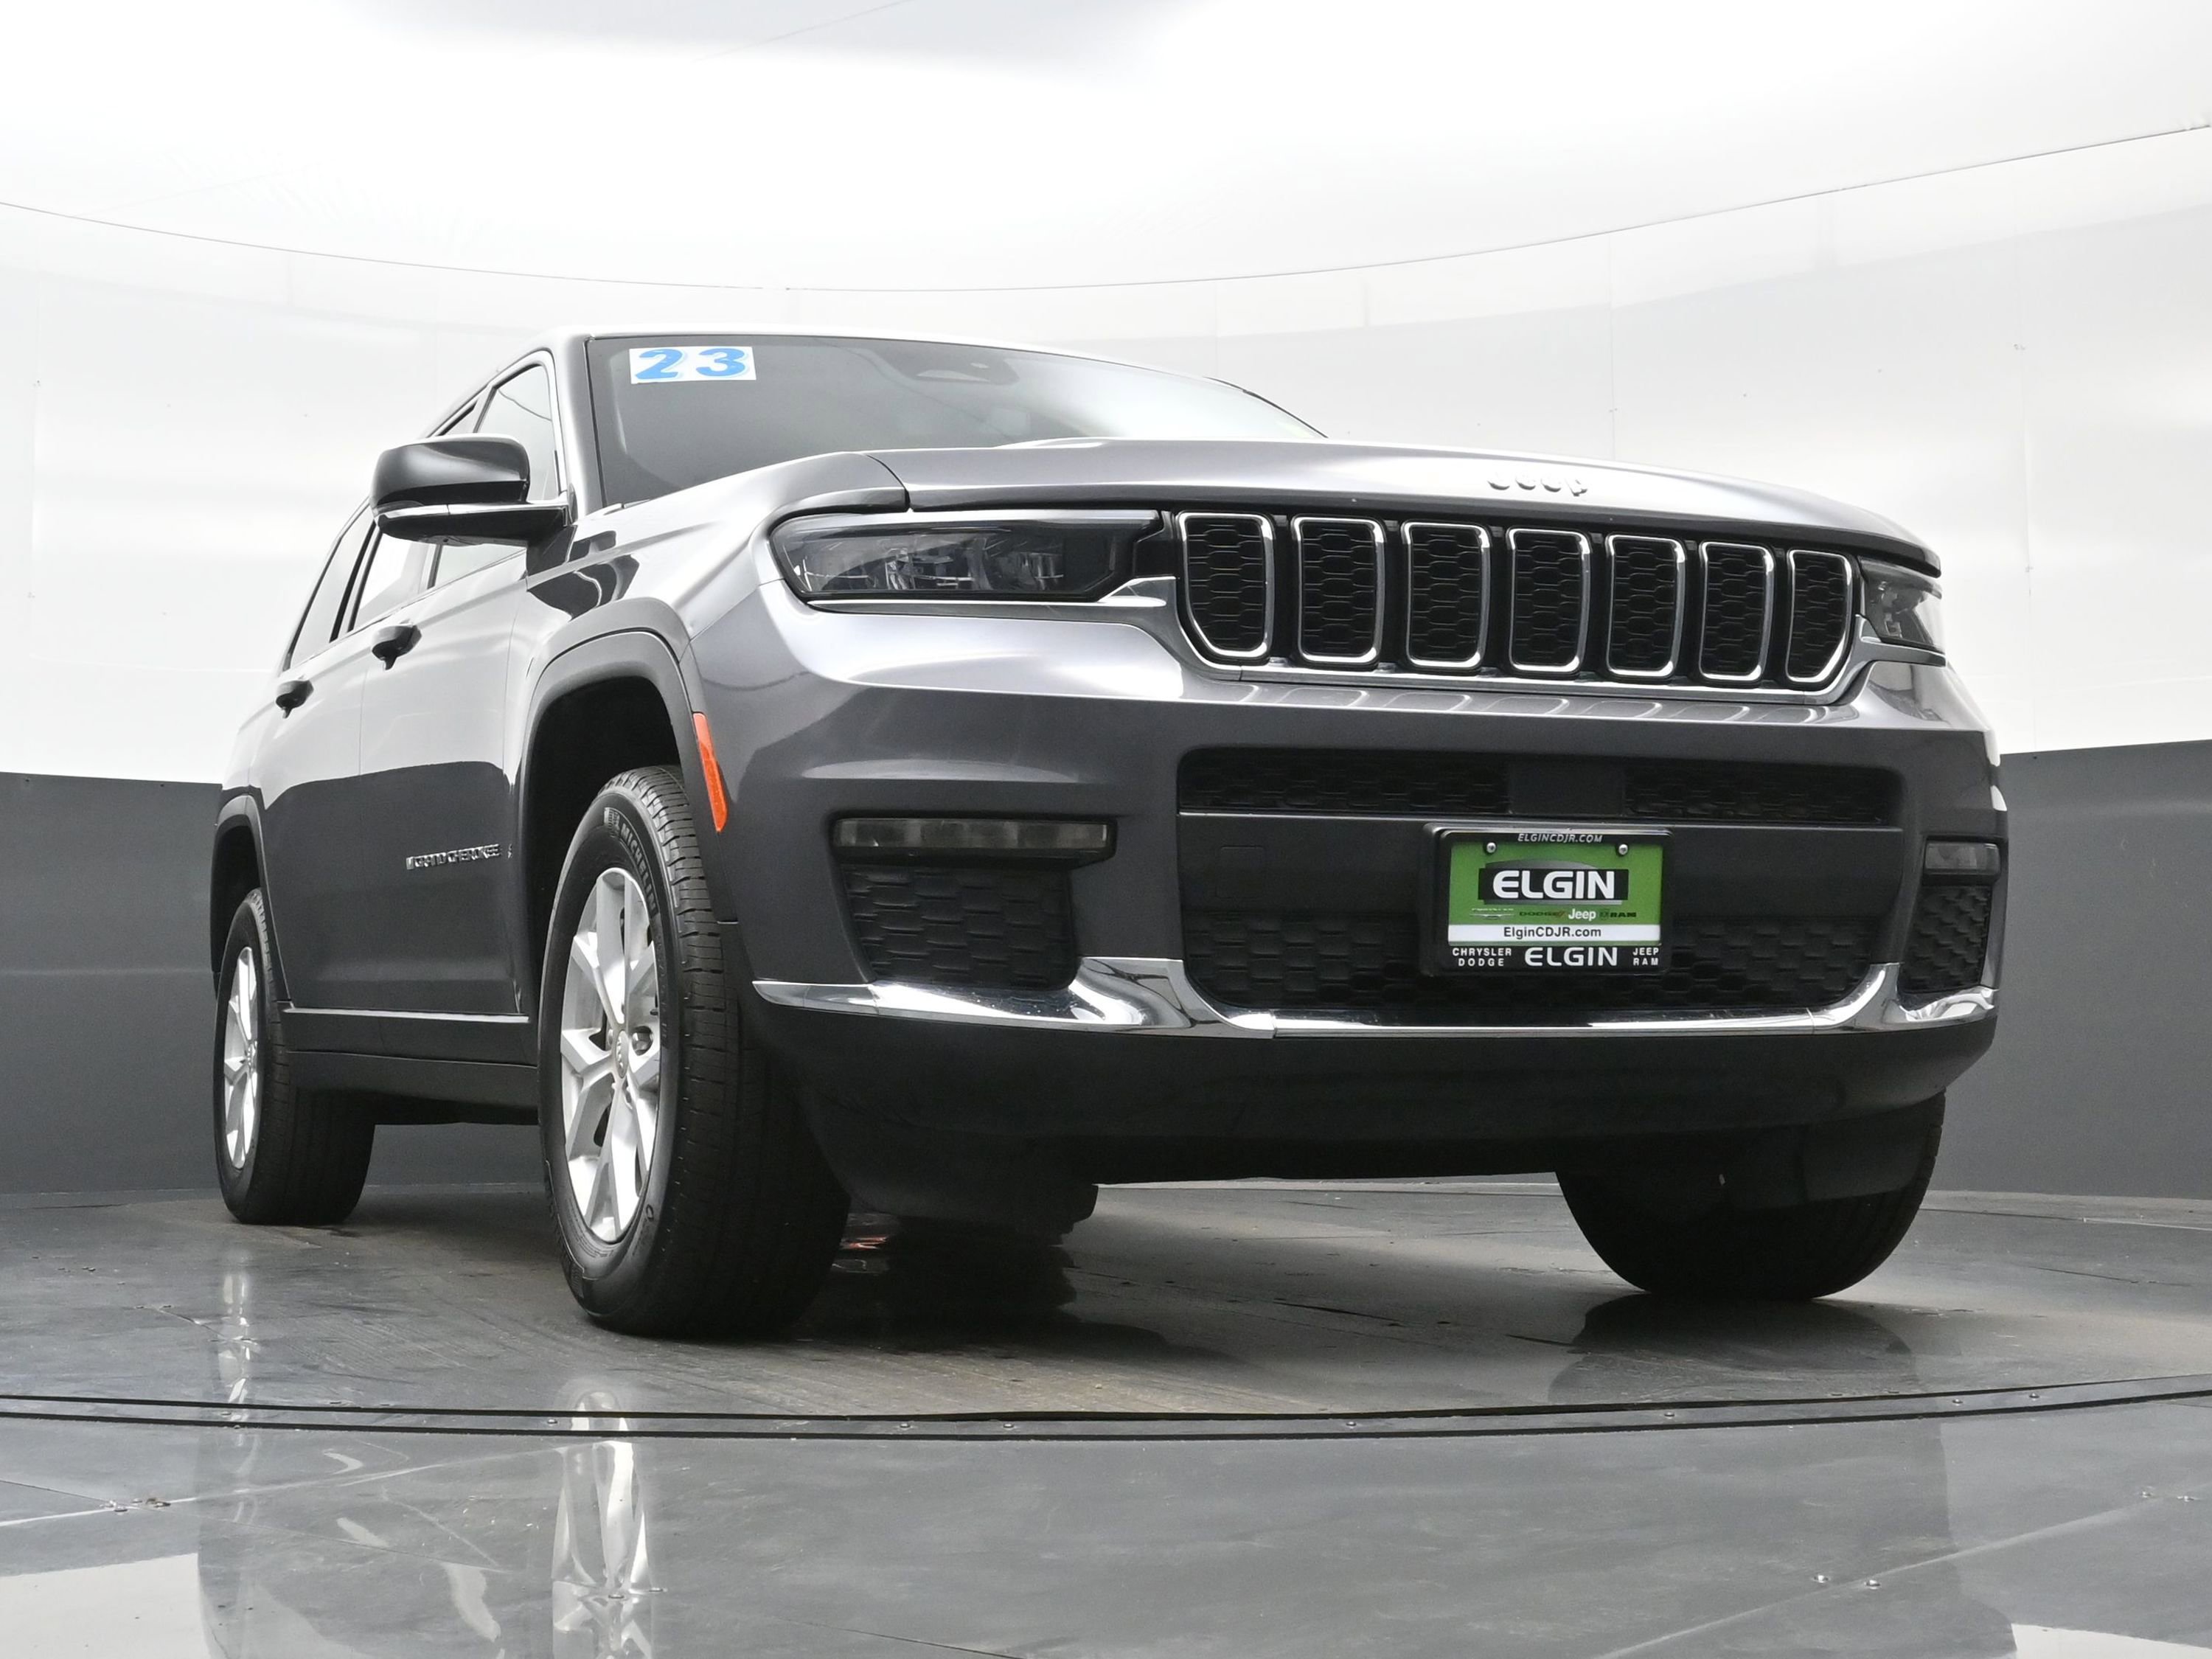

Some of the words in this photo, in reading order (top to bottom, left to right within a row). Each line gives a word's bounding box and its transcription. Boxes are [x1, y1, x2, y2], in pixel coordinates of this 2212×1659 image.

[1517, 832, 1603, 844] ELGINCDJR.COM
[621, 822, 655, 911] MICHELIN
[1492, 869, 1615, 899] ELGIN
[1568, 908, 1596, 921] Jeep
[1503, 926, 1601, 940] ElginCDJR.com
[1452, 947, 1512, 957] CHRYSLER
[1524, 947, 1618, 967] ELGIN
[1632, 947, 1660, 956] JEEP
[1458, 958, 1505, 967] DODGE
[1632, 957, 1659, 966] RAM
